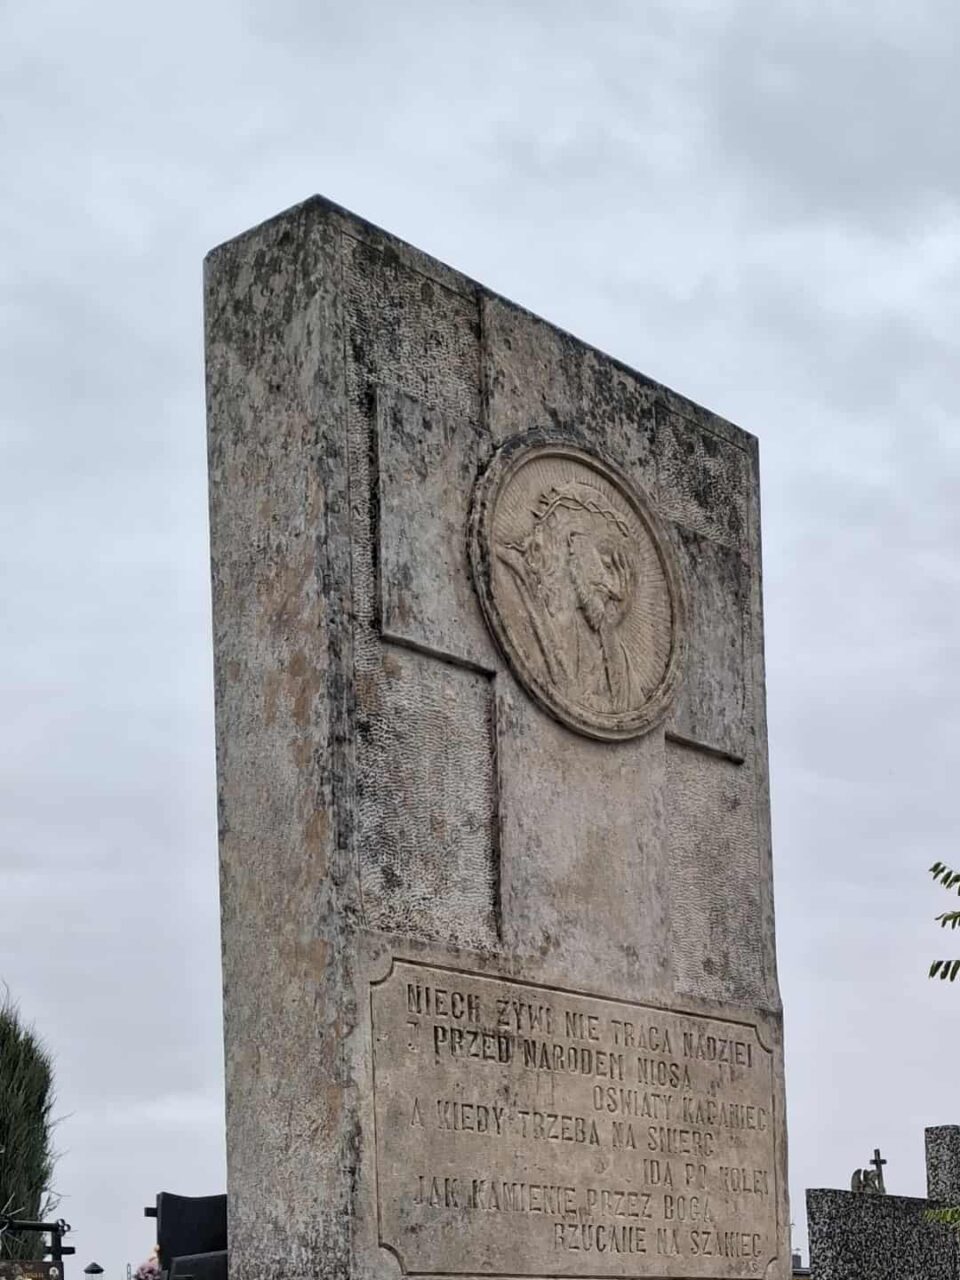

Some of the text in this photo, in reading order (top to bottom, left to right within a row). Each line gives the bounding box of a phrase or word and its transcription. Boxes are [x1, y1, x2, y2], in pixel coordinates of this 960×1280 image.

[408, 984, 480, 1022] NIECH
[565, 1011, 599, 1041] NIE
[683, 1031, 752, 1068] NADZIEI
[433, 1025, 511, 1064] PRZED
[523, 1039, 623, 1081] NARODEM
[411, 1097, 424, 1127] A
[437, 1100, 503, 1135] KIEDY
[518, 1110, 600, 1146] TRZEBA
[612, 1121, 636, 1149] NA
[413, 1175, 713, 1223] JAK KAMIENIE PRZEZ BOGA
[685, 1163, 707, 1189] PO
[657, 1228, 680, 1256] NA
[690, 1230, 762, 1258] SZANIEC
